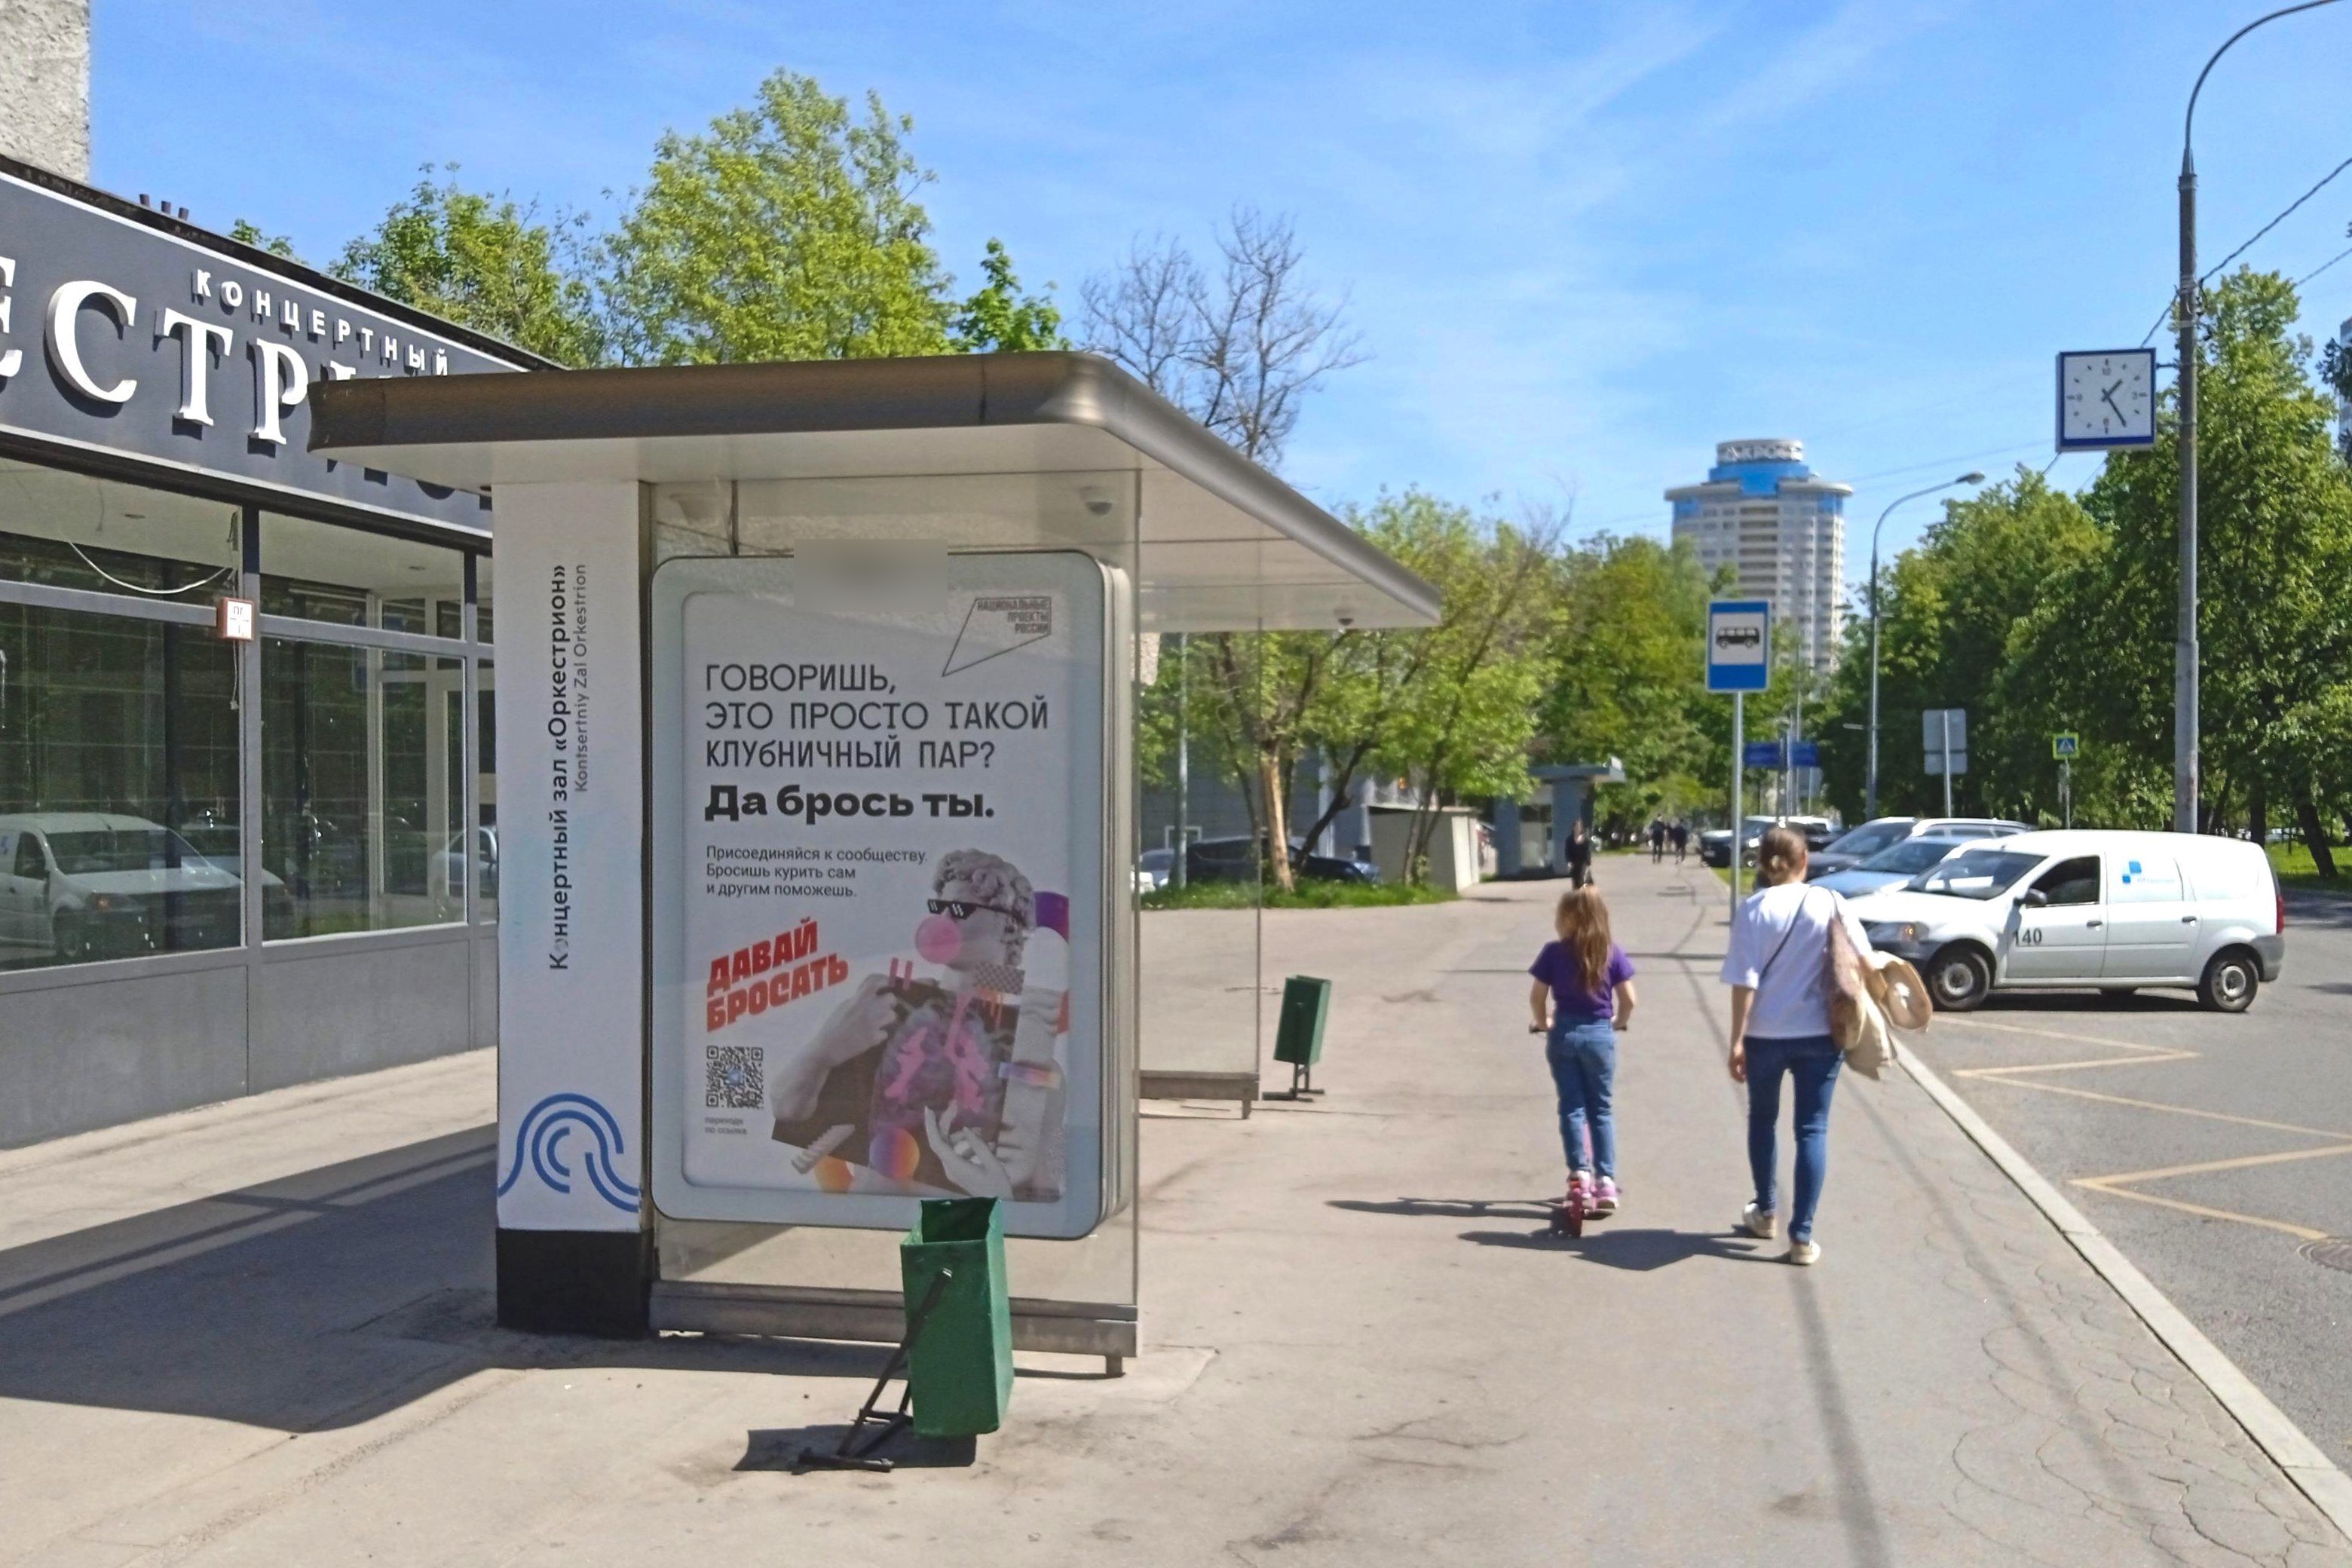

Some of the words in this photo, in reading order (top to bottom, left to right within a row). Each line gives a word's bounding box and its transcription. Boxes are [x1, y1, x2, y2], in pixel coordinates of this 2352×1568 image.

[192, 268, 448, 375] КОНЦЕРТНЫЙ
[572, 564, 588, 658] Orkestrion
[548, 565, 571, 752] «Оркестрион»
[574, 663, 588, 689] Zal
[706, 663, 897, 696] ГОВОРИШЬ,
[706, 702, 774, 731] ЭТО
[790, 702, 930, 731] ПРОСТО
[945, 695, 1049, 731] ТАКОЙ
[574, 691, 590, 793] Kontsertniy
[919, 740, 997, 770] ПАР?
[553, 758, 568, 802] зал
[705, 785, 769, 823] Да
[776, 784, 915, 827] брось
[922, 794, 996, 819] ты.
[706, 845, 821, 862] Присоединяйся
[825, 850, 834, 862] к
[837, 848, 928, 866] сообществу.
[706, 863, 771, 879] Бросишь
[774, 867, 824, 882] курить
[828, 868, 857, 880] сам
[706, 884, 715, 895] и
[718, 884, 771, 899] другим
[774, 885, 858, 899] поможешь.
[2013, 927, 2043, 947] 140
[707, 916, 817, 999] ДАВАЙ
[707, 953, 849, 1033] БРОСАТЬ
